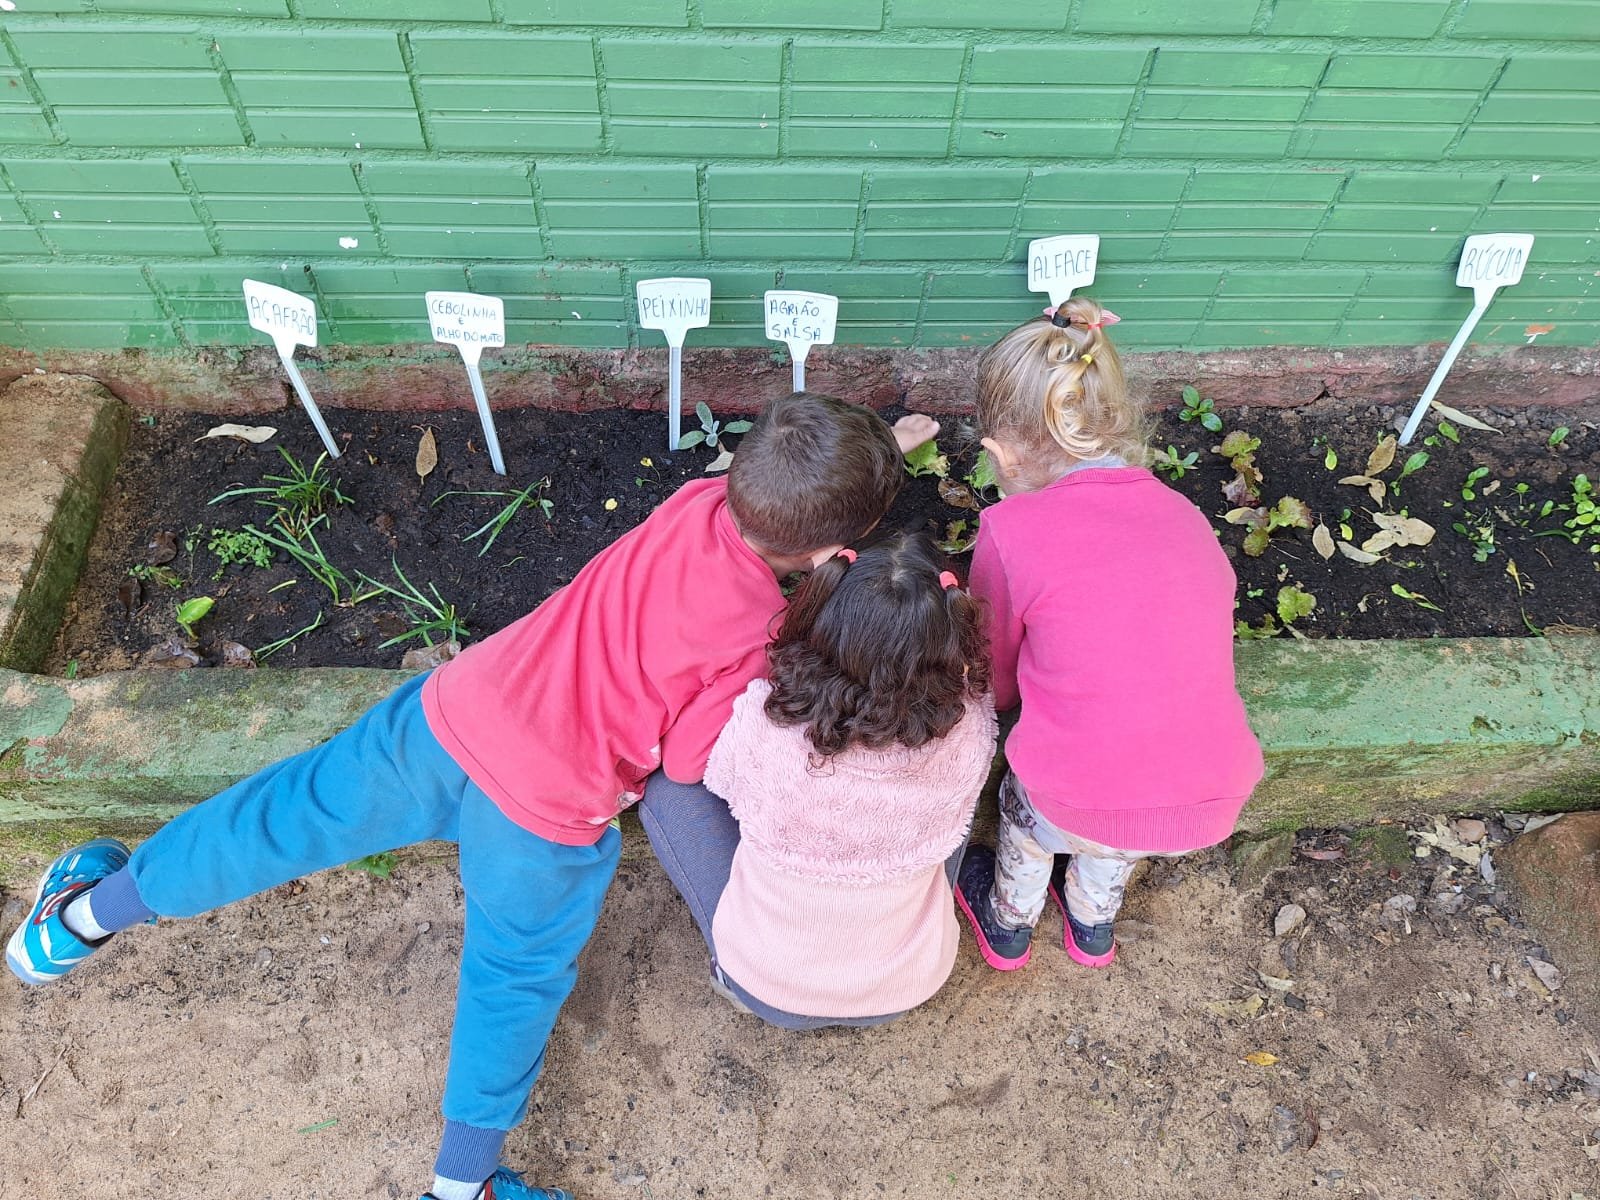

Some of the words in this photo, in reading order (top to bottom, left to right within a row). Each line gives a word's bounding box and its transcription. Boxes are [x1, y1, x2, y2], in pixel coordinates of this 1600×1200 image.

[1033, 249, 1092, 282] ALFACE
[431, 299, 497, 320] CEBOLINHA
[642, 294, 709, 319] PEIXINHO
[770, 299, 820, 317] AGRIÃO
[250, 296, 315, 336] AÇAFRÃO
[458, 317, 465, 325] E
[792, 317, 799, 326] E
[436, 326, 461, 339] ALHO
[463, 331, 479, 342] DO
[480, 333, 504, 343] MATO
[771, 323, 821, 341] SALSA
